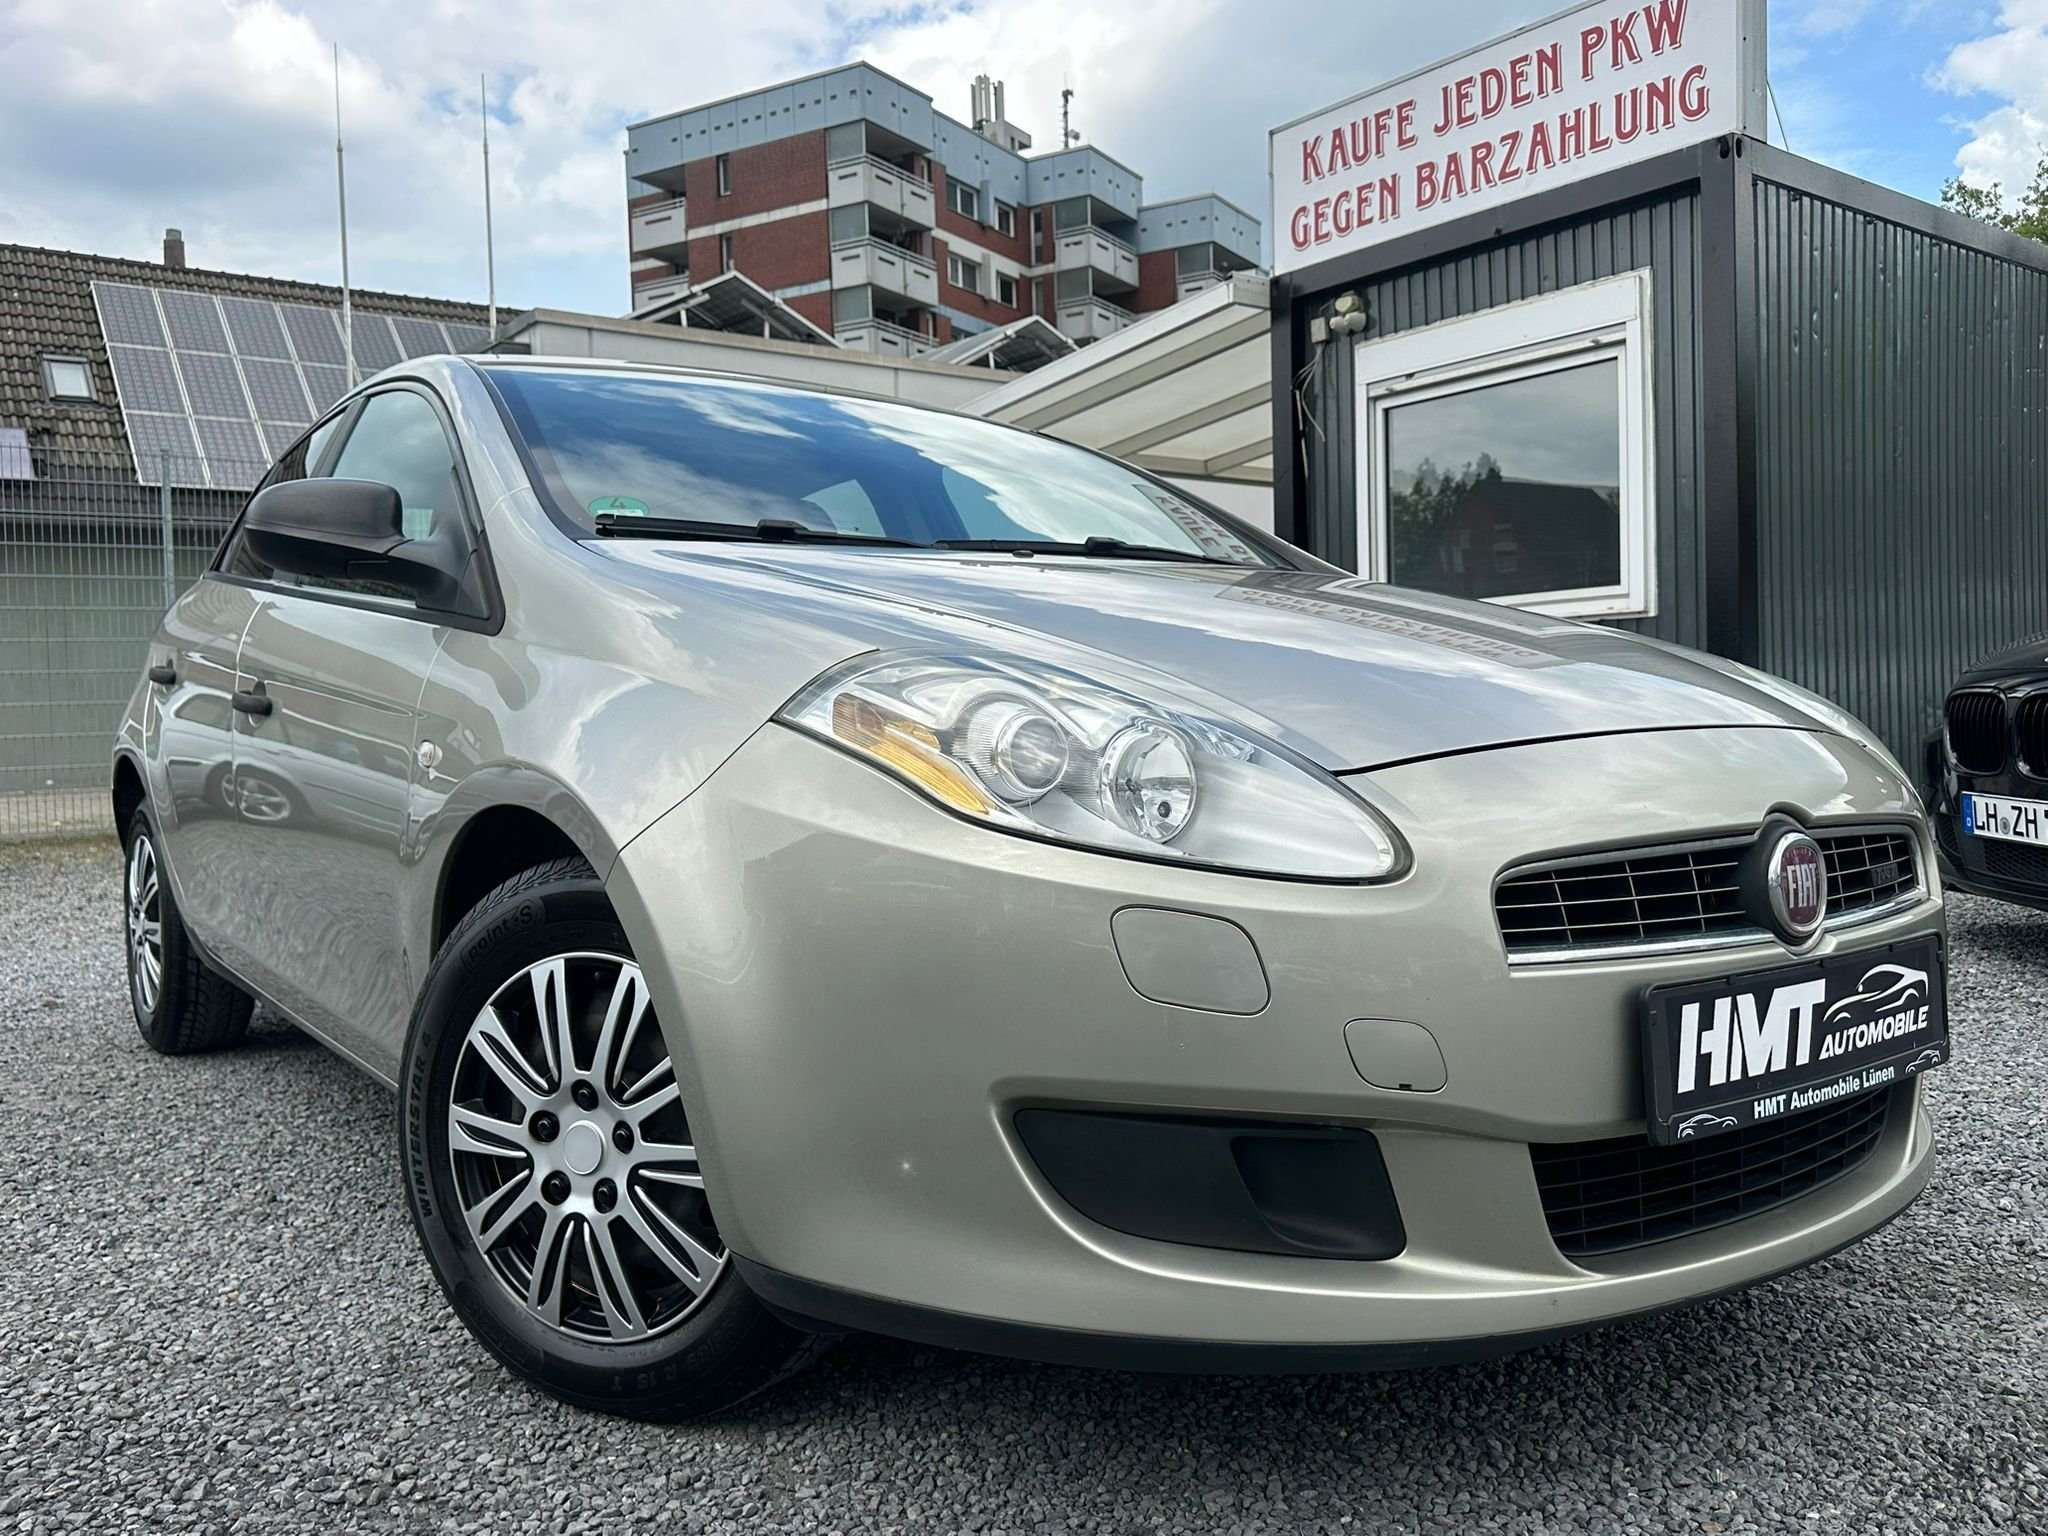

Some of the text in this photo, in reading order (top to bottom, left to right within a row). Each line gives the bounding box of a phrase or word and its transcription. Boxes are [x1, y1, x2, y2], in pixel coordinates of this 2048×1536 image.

[1301, 0, 1688, 184] KAUFE JEDEN PKW
[1290, 64, 1711, 252] GEGEN BARZAHLUNG
[1973, 800, 2039, 839] LH ZH
[1786, 863, 1817, 909] FIAT
[1677, 978, 1826, 1095] HMT
[1819, 1004, 1930, 1060] AUTOMOBILE
[1753, 1065, 1895, 1119] HMT Automobile Lünen
[408, 1055, 433, 1217] WINTERSTAR
